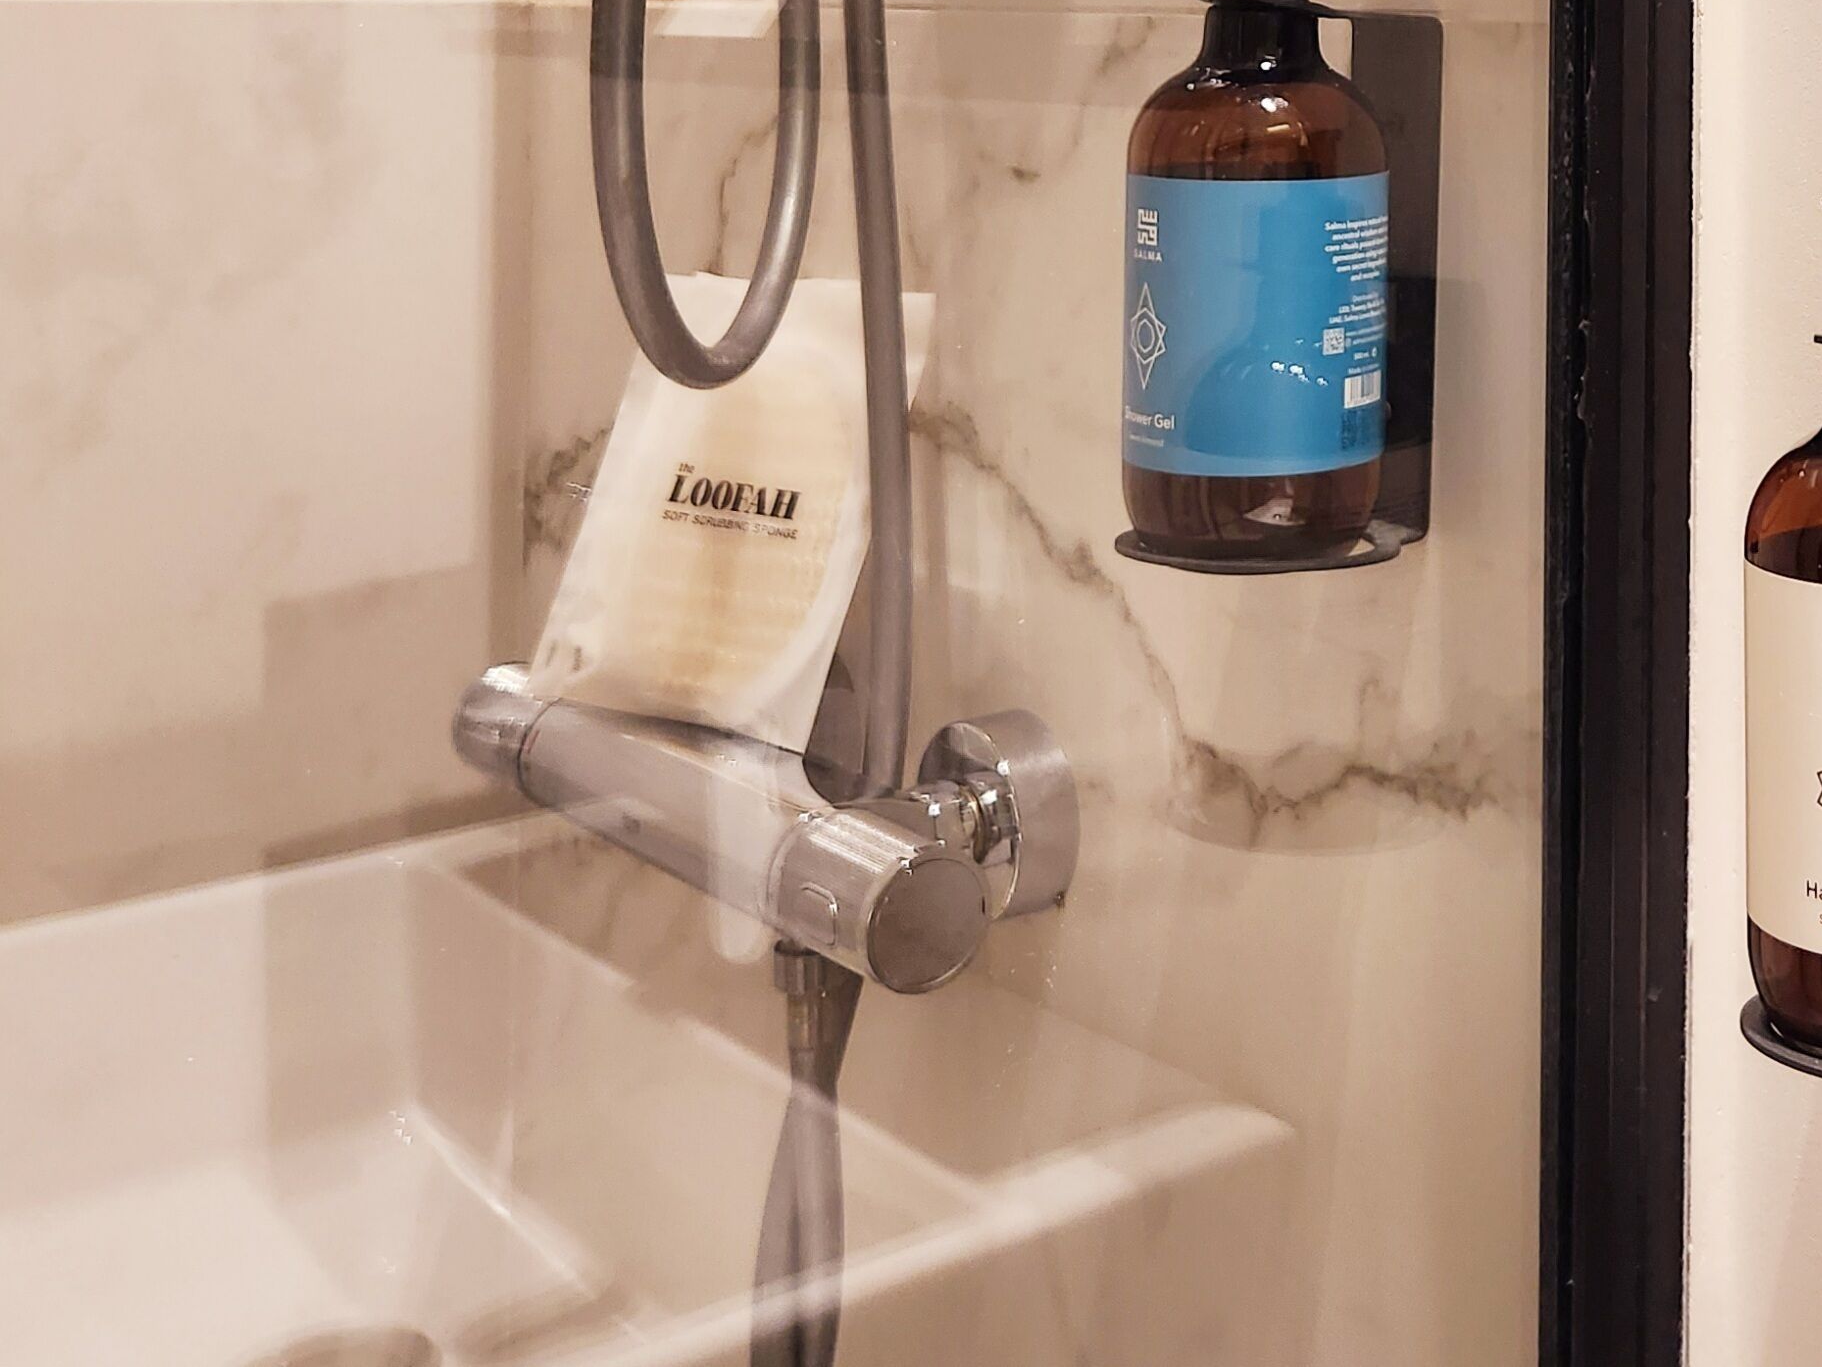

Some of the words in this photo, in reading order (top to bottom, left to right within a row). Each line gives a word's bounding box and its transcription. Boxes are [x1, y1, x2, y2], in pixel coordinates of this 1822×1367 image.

[1154, 413, 1175, 430] Gel
[667, 474, 803, 520] LOOFAH
[662, 508, 691, 521] SOFT
[691, 515, 750, 531] SCRUBBING
[753, 523, 799, 540] SPONGE
